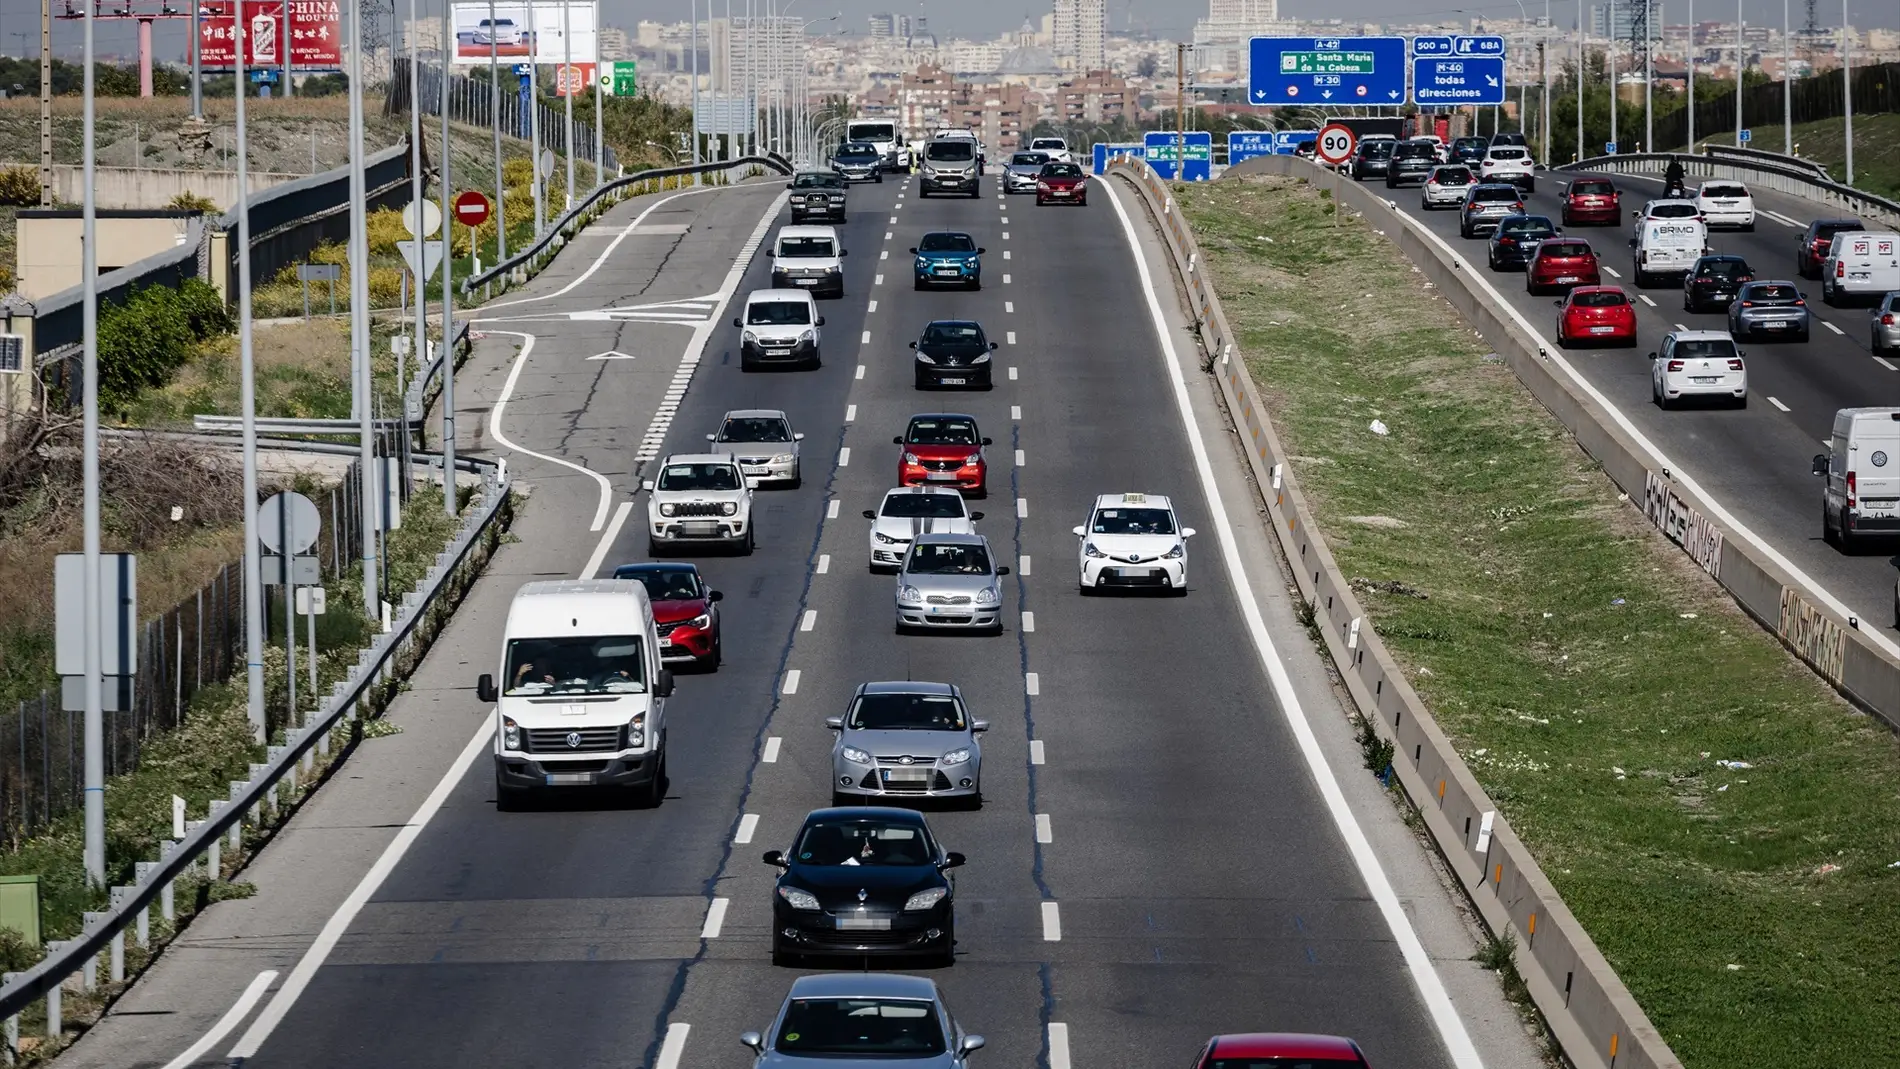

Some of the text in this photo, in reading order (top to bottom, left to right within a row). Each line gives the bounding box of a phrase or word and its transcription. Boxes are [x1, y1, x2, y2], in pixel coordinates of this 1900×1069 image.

[288, 1, 339, 13] CHINA
[1437, 64, 1462, 72] M-40
[1434, 76, 1466, 84] todas
[1419, 88, 1481, 97] direcciones
[1324, 136, 1348, 150] 90
